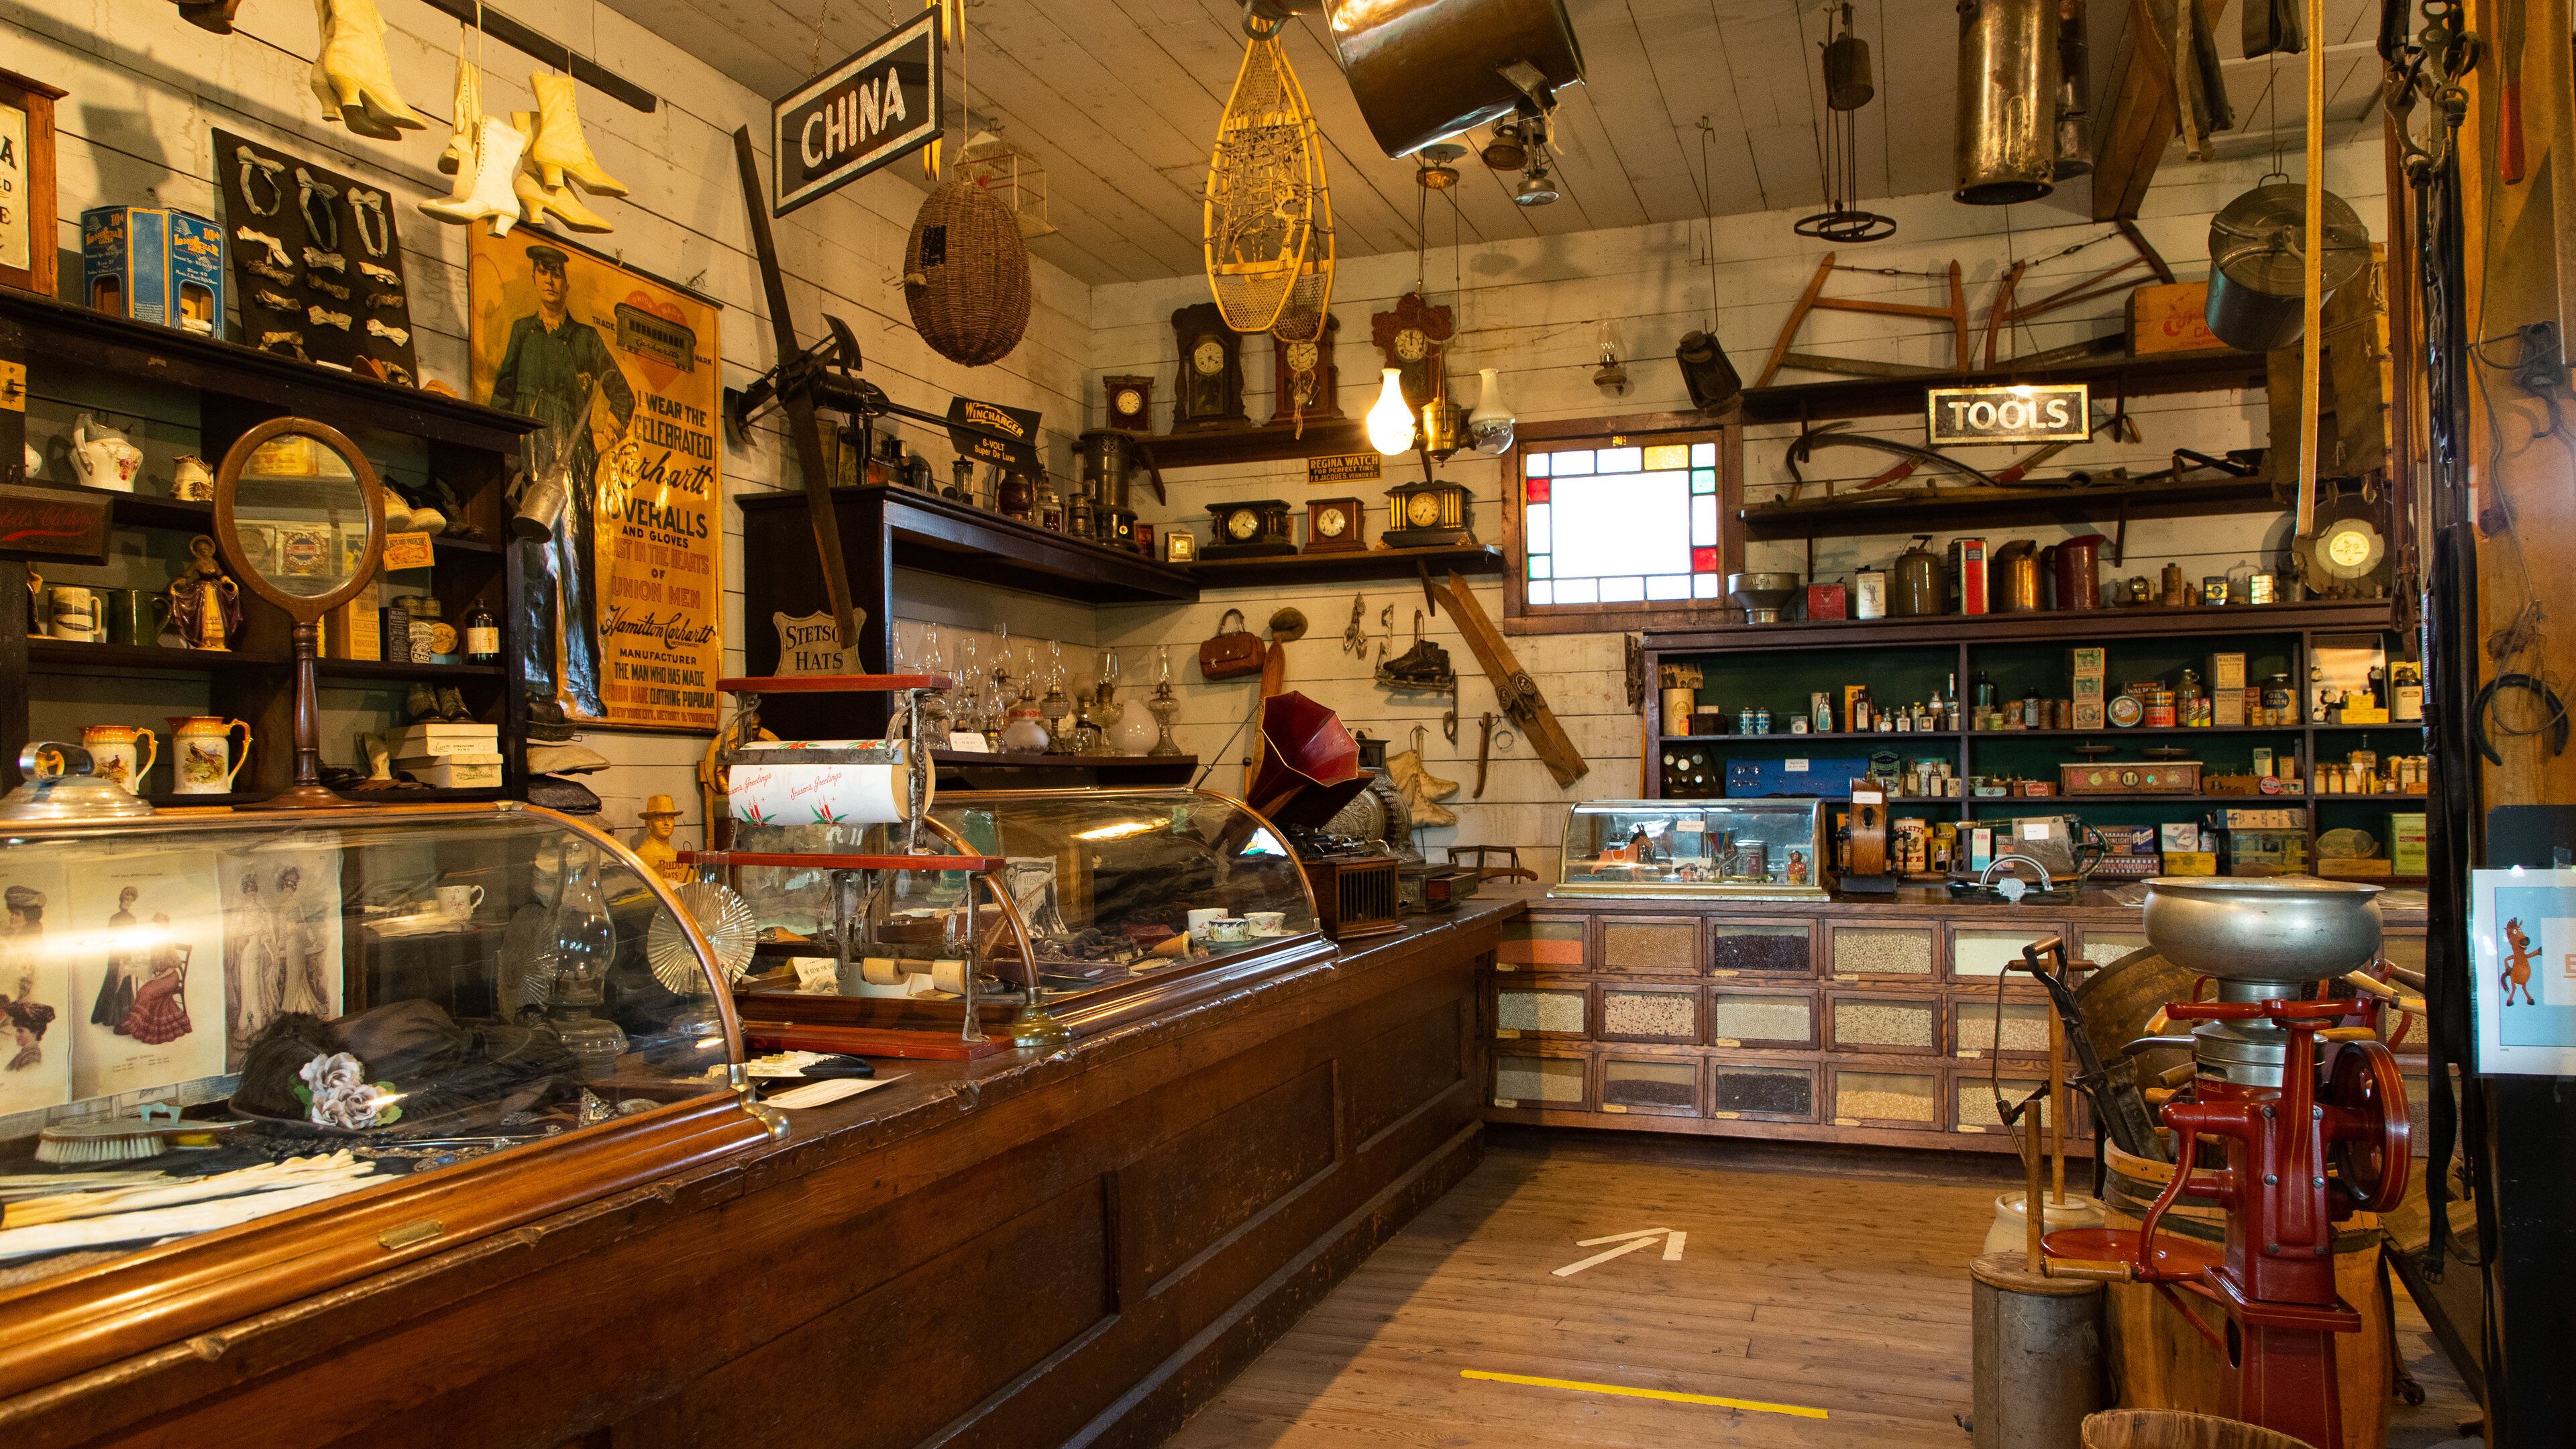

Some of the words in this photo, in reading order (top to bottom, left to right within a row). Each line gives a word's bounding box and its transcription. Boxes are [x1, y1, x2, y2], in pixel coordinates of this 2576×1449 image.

[801, 67, 906, 168] CHINA
[632, 296, 653, 309] UNION
[661, 305, 681, 318] MADE
[592, 317, 615, 331] TRADE
[638, 390, 641, 407] I
[645, 392, 682, 420] WEAR
[685, 405, 706, 427] THE
[965, 402, 1024, 437] WINCHARGER
[1948, 398, 2069, 431] TOOLS
[635, 414, 712, 460] CELEBRATED
[983, 438, 1005, 451] 6-VOLT
[974, 445, 991, 456] Super
[993, 450, 1000, 459] De
[1002, 452, 1016, 462] Luxe
[1310, 458, 1343, 470] REGINA
[1345, 455, 1379, 467] WATCH
[619, 442, 714, 495] Carhartt
[606, 491, 708, 539] OVERALLS
[622, 525, 643, 538] AND
[649, 531, 688, 549] GLOVES
[648, 543, 668, 567] THE
[671, 548, 709, 575] HEARTS
[651, 568, 665, 579] OF
[1749, 578, 1771, 586] ALFA
[612, 576, 661, 602] UNION
[669, 586, 700, 609] MEN
[600, 605, 663, 637] Hamilton
[664, 612, 716, 649] Carhartt
[786, 625, 840, 652] STETSO
[620, 648, 696, 665] MANUFACTURER
[795, 651, 843, 671] HATS
[614, 662, 629, 680] THE
[631, 663, 649, 682] MAN
[650, 665, 666, 683] WHO
[667, 668, 680, 685] HAS
[682, 669, 706, 687] MADE
[604, 684, 629, 702] UNION
[631, 686, 649, 704] MADE
[650, 688, 681, 707] CLOTHING
[682, 690, 715, 709] POPULAR
[744, 772, 773, 793] Greetings
[814, 771, 843, 793] Greetings
